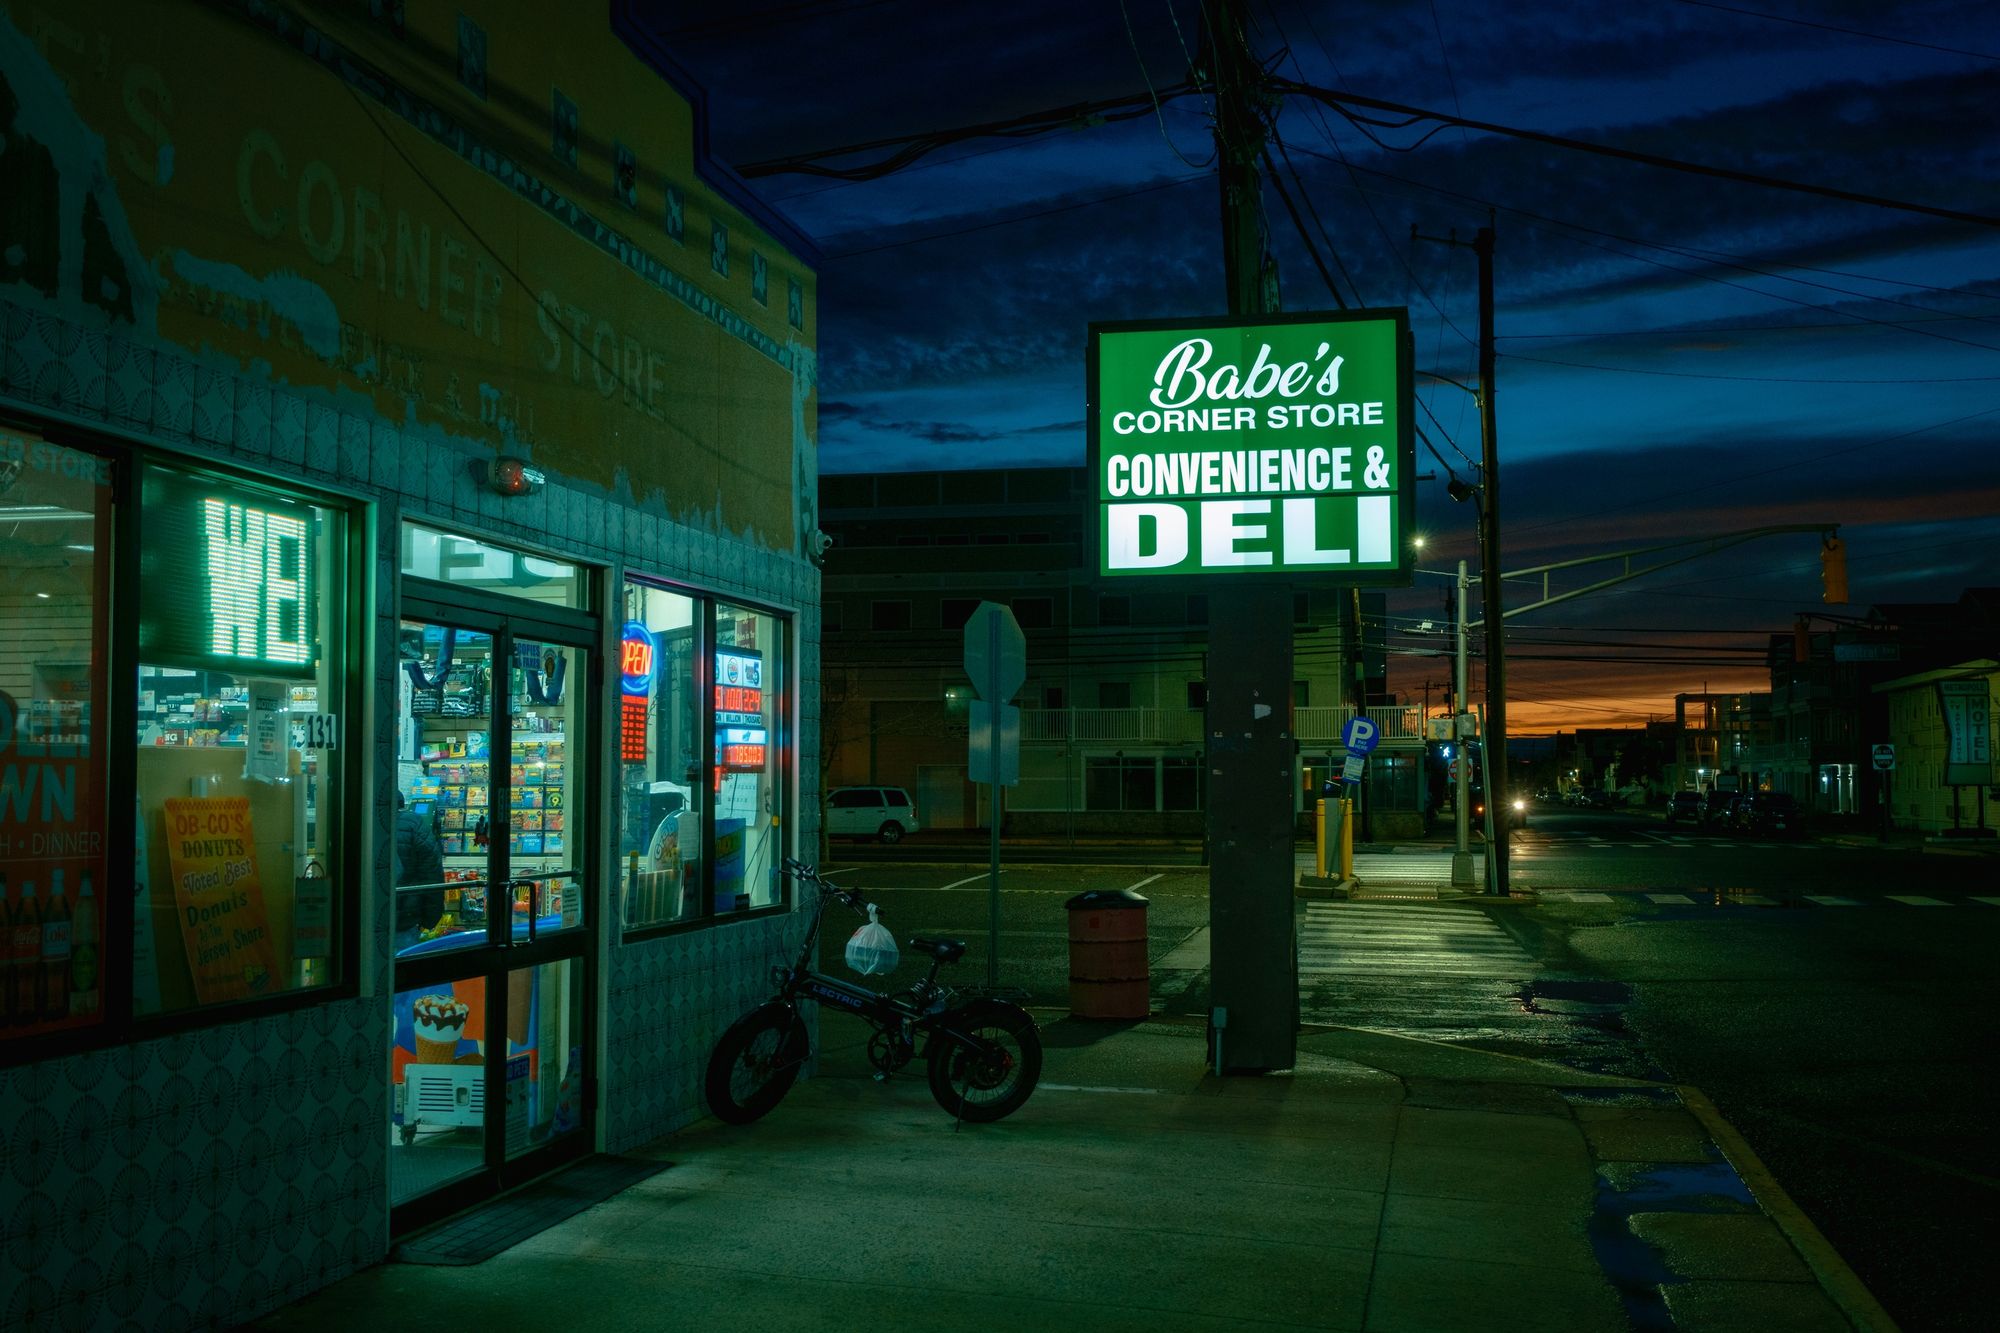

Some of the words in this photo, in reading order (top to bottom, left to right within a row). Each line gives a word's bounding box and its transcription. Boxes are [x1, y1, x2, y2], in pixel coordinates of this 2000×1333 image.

[236, 130, 505, 347] CORNER
[535, 289, 671, 420] STORE
[1149, 337, 1345, 409] Babe's
[1112, 407, 1256, 435] CORNER
[1266, 401, 1384, 430] STORE
[31, 440, 112, 486] STORE
[1107, 446, 1353, 497] CONVENIENCE
[1363, 445, 1391, 489] &
[1107, 495, 1392, 569] DELI
[518, 642, 540, 658] COPIES
[307, 715, 335, 749] 131
[1348, 719, 1374, 748] P
[1971, 698, 1985, 762] MOTEL
[32, 831, 102, 856] DINNER
[175, 813, 246, 836] OB-CO'S
[181, 838, 246, 859] DONUTS
[183, 864, 220, 897] Voted
[223, 857, 255, 887] Best
[186, 890, 249, 928] Donuts
[197, 940, 231, 967] Jersey
[232, 925, 265, 951] Shore
[811, 984, 863, 1008] LECTRIC
